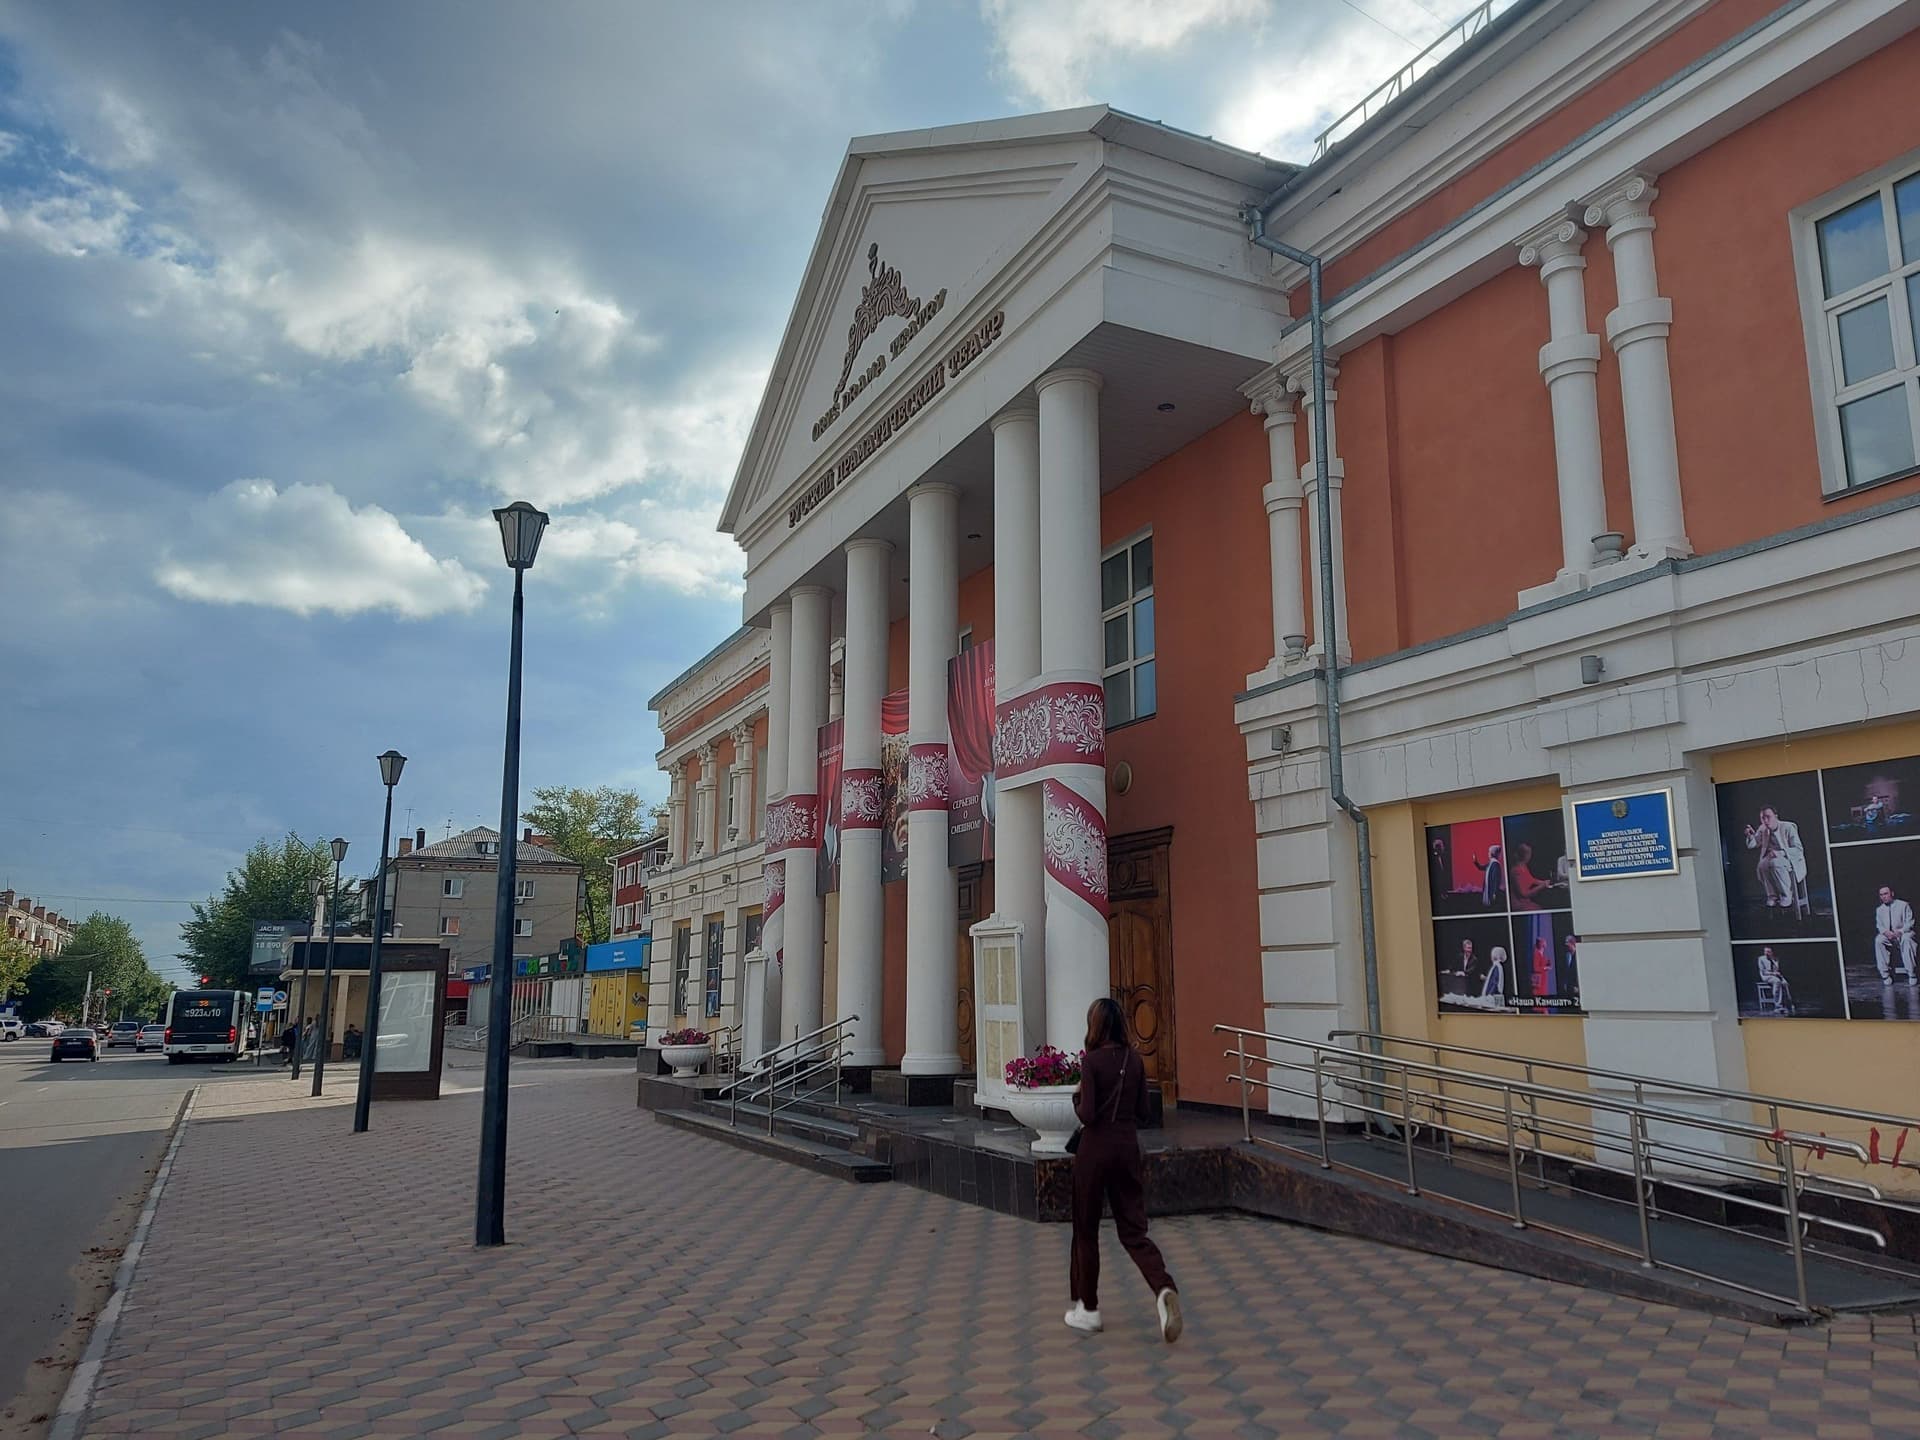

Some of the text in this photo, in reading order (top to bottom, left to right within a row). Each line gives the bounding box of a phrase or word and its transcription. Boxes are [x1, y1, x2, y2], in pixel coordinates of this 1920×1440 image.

[788, 310, 1005, 528] РУССКИЙ ДРАМАТИЧЕСКИЙ ТЕАТР
[841, 355, 887, 412] DRAMA
[890, 288, 948, 361] TEATRY
